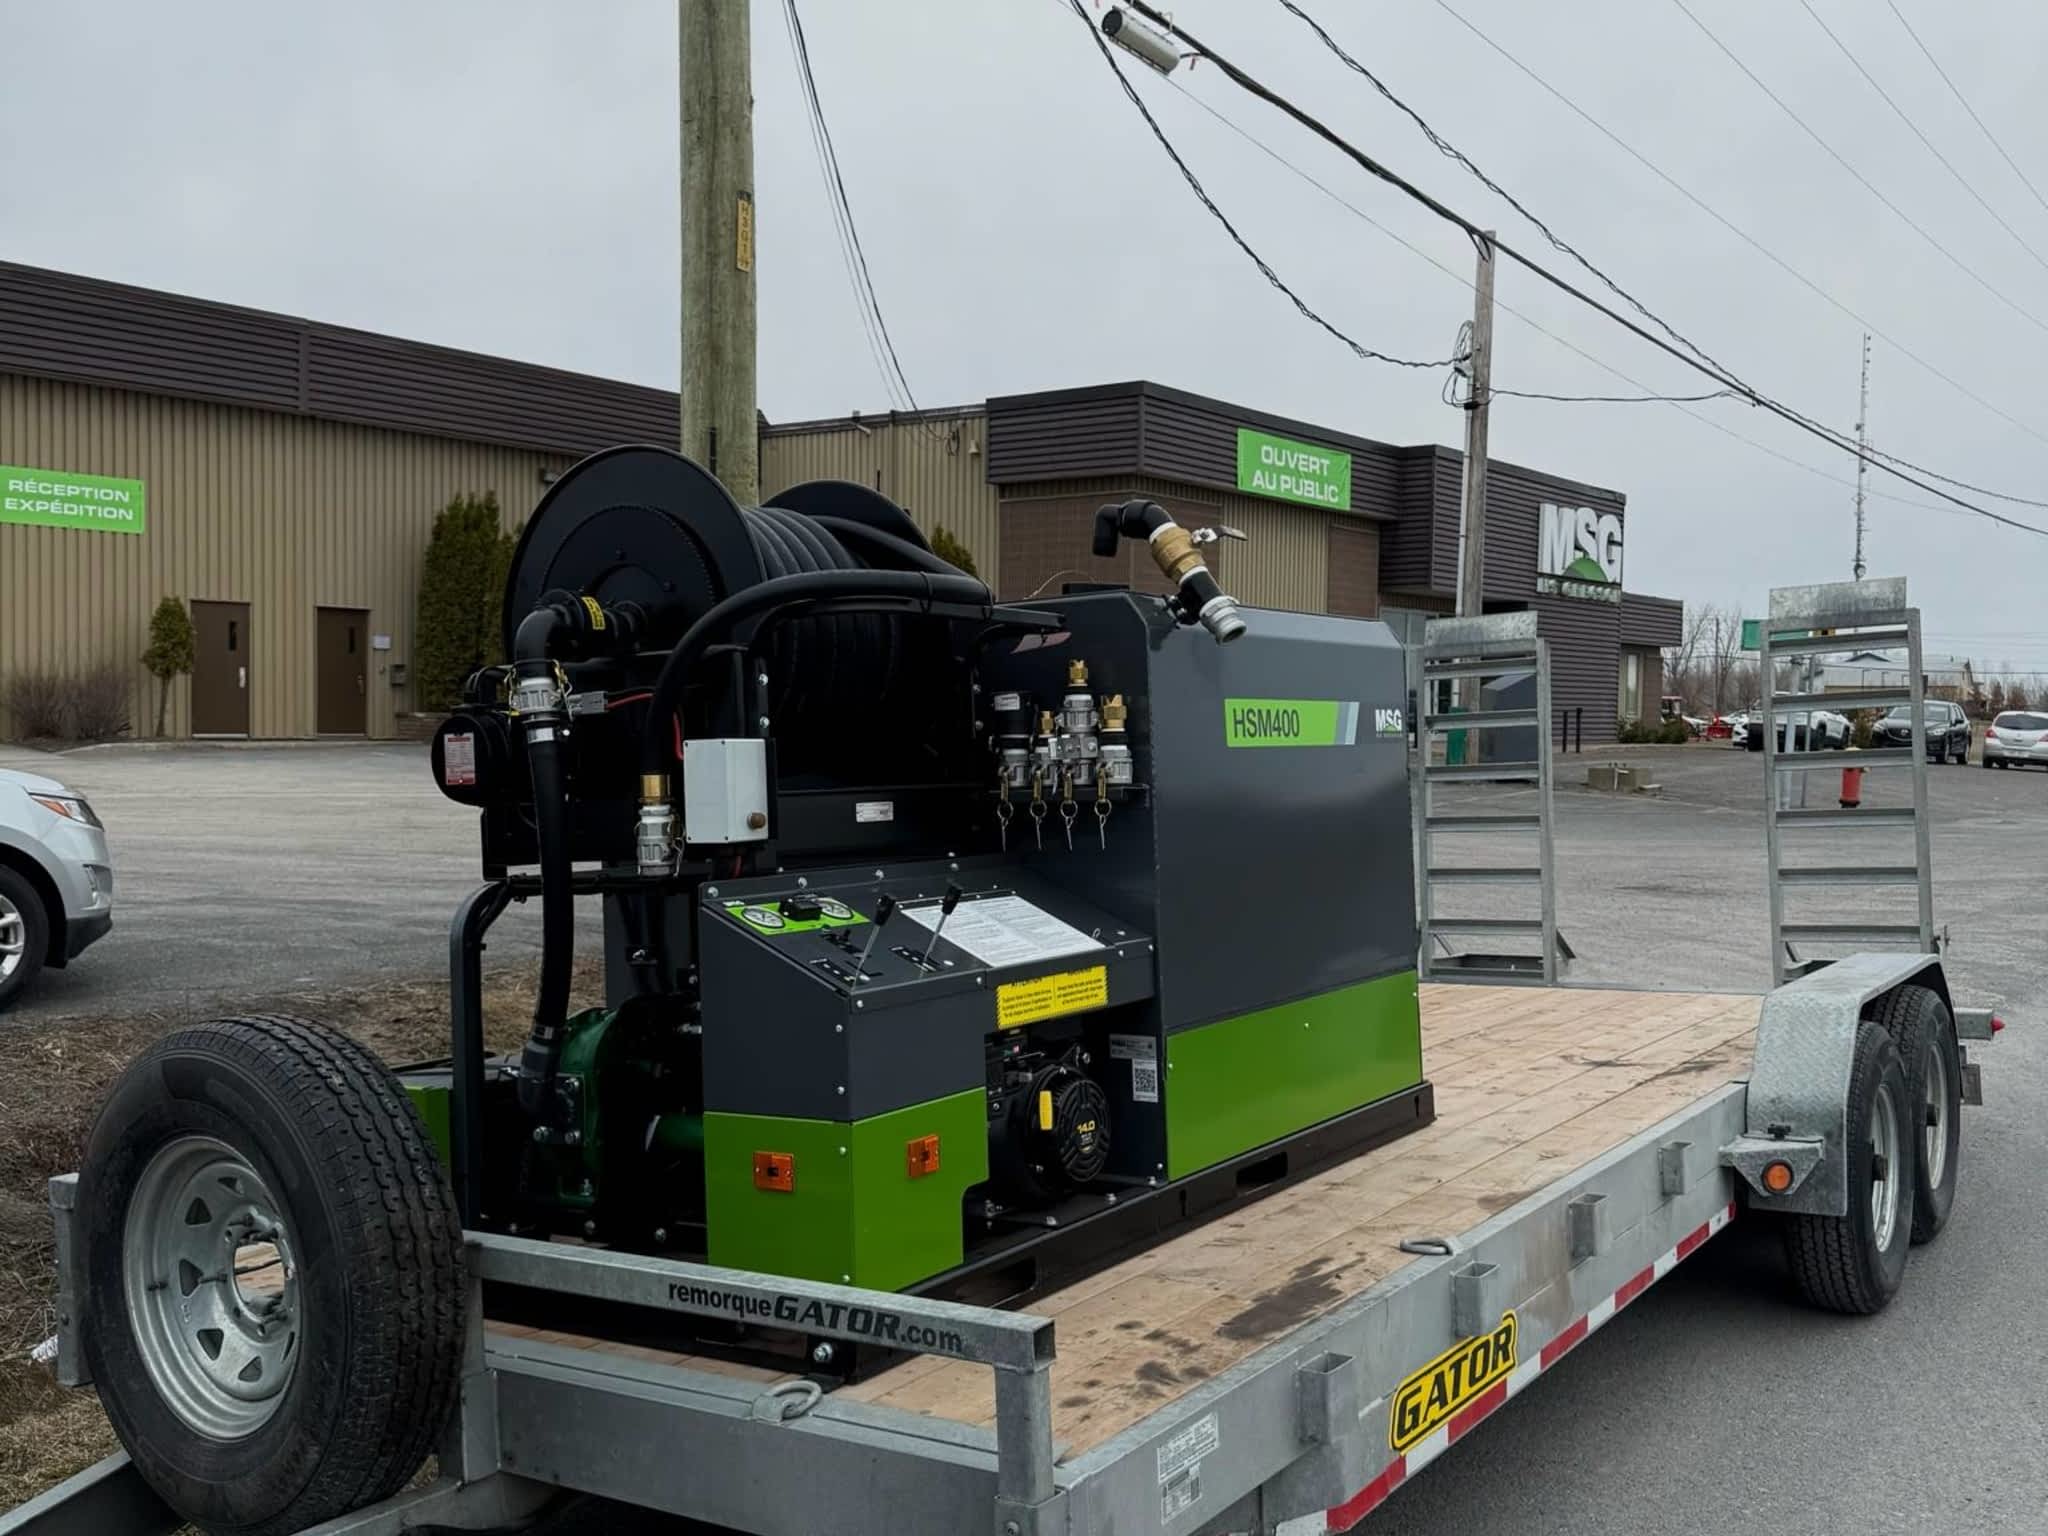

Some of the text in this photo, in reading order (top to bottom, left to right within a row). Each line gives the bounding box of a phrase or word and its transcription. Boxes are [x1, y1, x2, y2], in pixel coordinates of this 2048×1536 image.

[1261, 444, 1331, 477] OUVERT
[8, 478, 129, 503] RÉCEPTION
[1252, 469, 1339, 503] AU PUBLIC
[4, 497, 133, 520] EXPÉDITION
[1537, 503, 1622, 584] MSG
[1232, 707, 1300, 738] HSM400
[1375, 709, 1402, 732] MSG
[1397, 1323, 1513, 1439] GATOR
